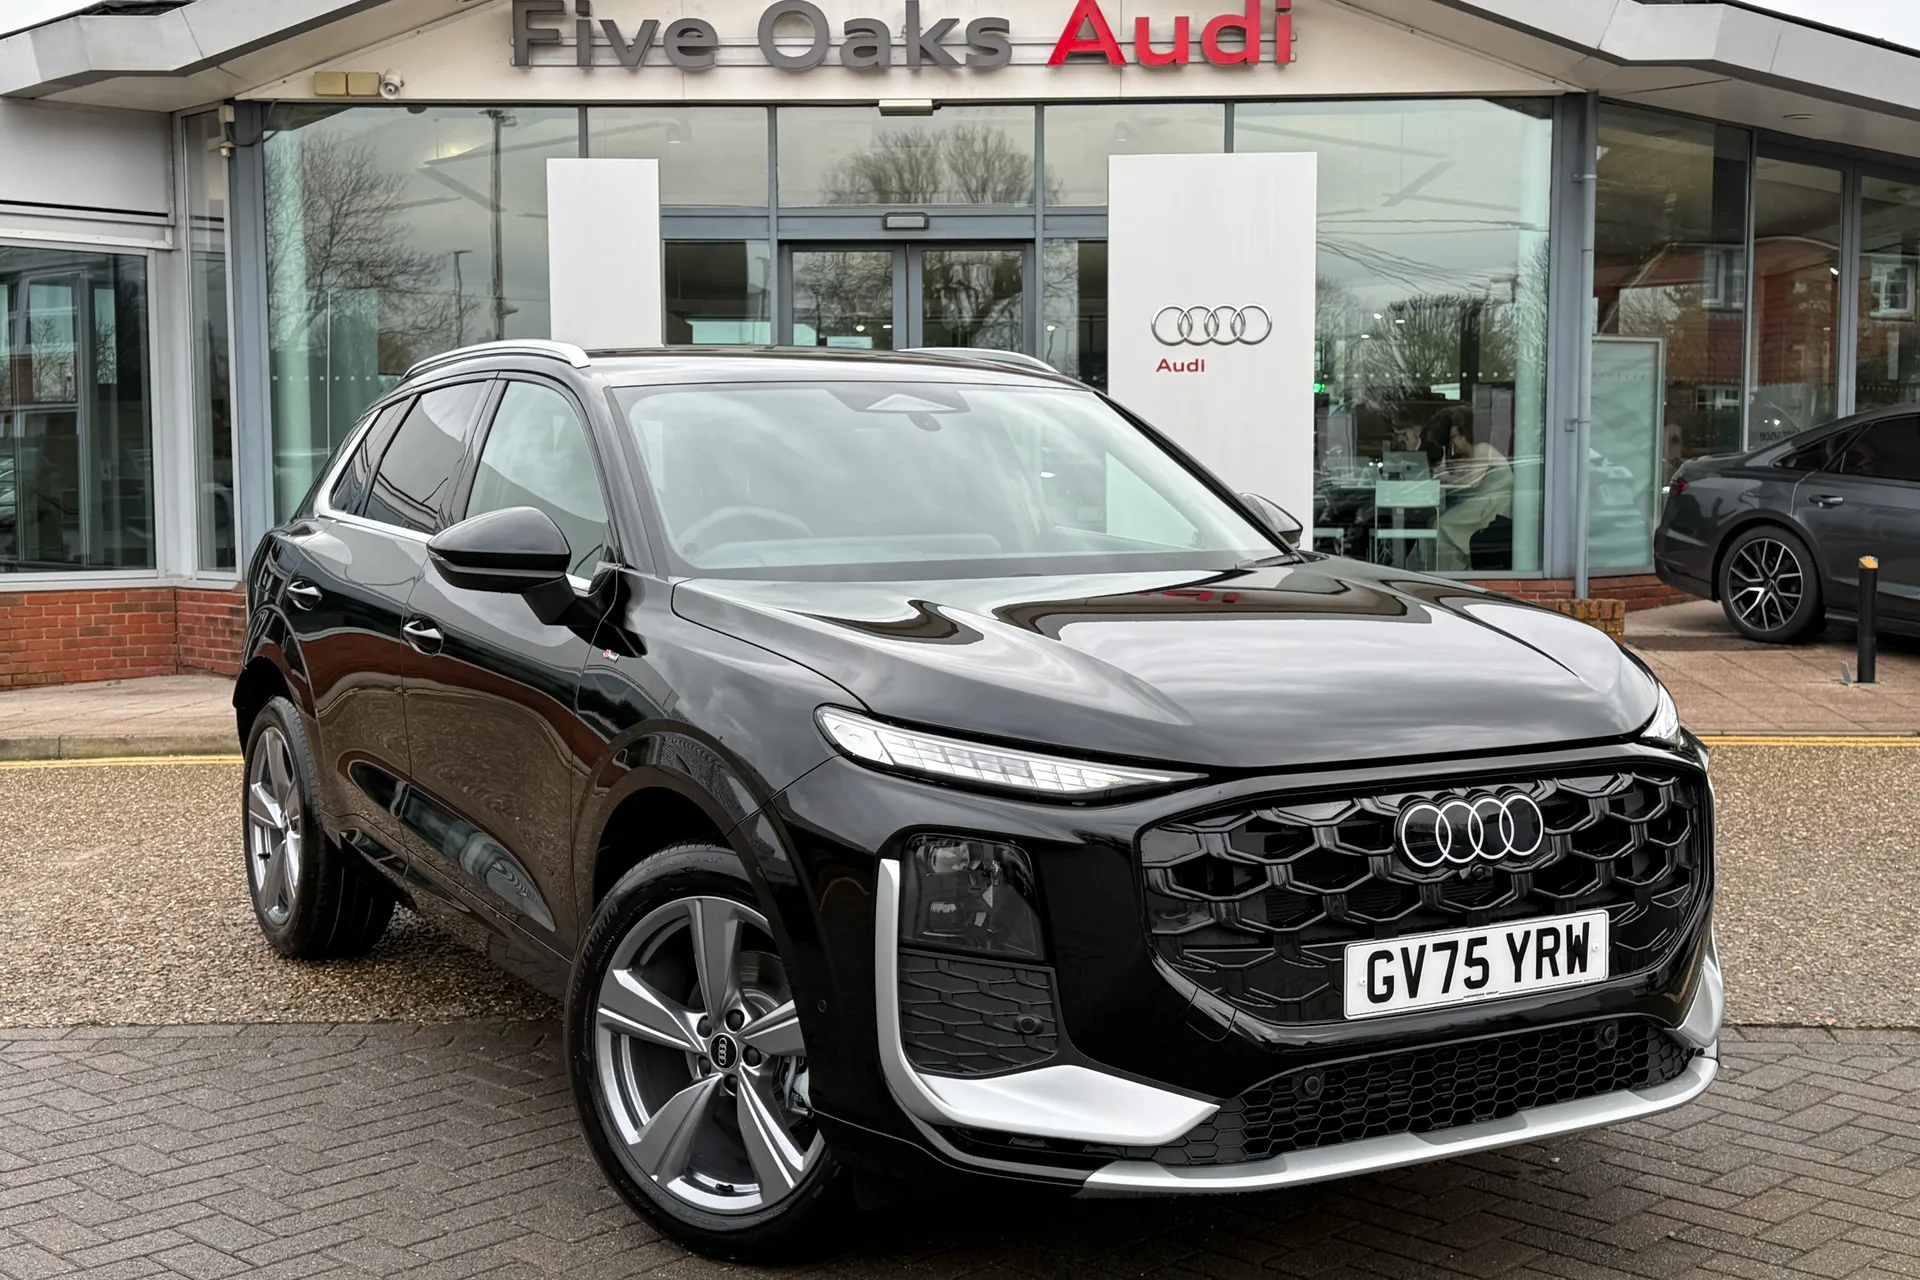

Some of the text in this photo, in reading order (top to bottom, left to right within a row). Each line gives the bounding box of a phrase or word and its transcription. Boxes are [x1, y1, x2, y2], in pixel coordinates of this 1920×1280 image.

[513, 0, 1292, 71] Five Oaks Audi
[1156, 358, 1205, 373] Audi
[1366, 921, 1590, 1004] GV75 YRW
